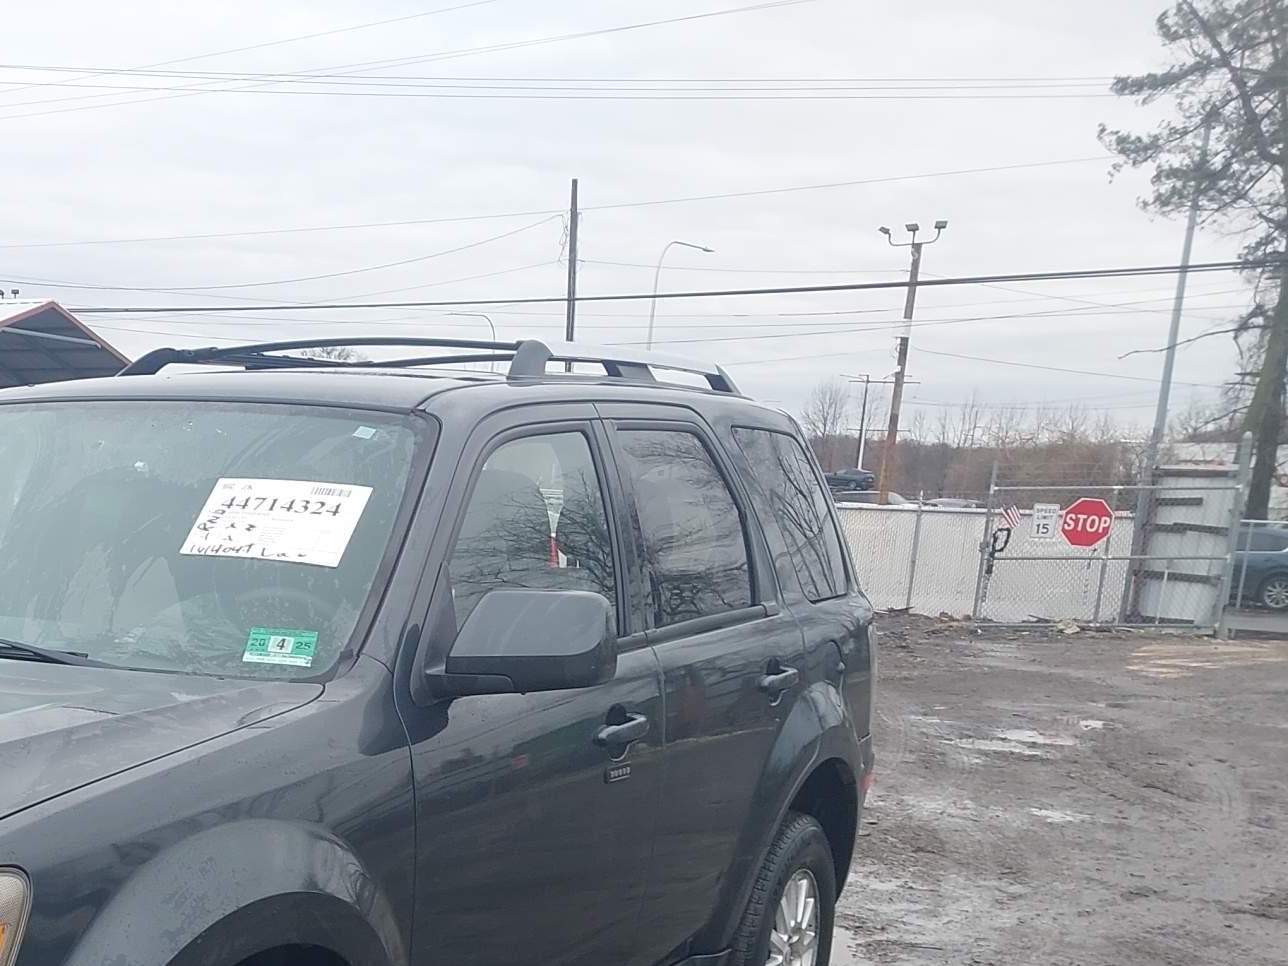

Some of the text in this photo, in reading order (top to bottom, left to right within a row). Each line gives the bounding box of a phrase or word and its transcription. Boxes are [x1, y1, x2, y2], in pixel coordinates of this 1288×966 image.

[221, 496, 341, 516] 44714324
[1036, 523, 1050, 535] 15
[1064, 513, 1110, 533] STOP
[250, 638, 312, 651] 20 4 25
